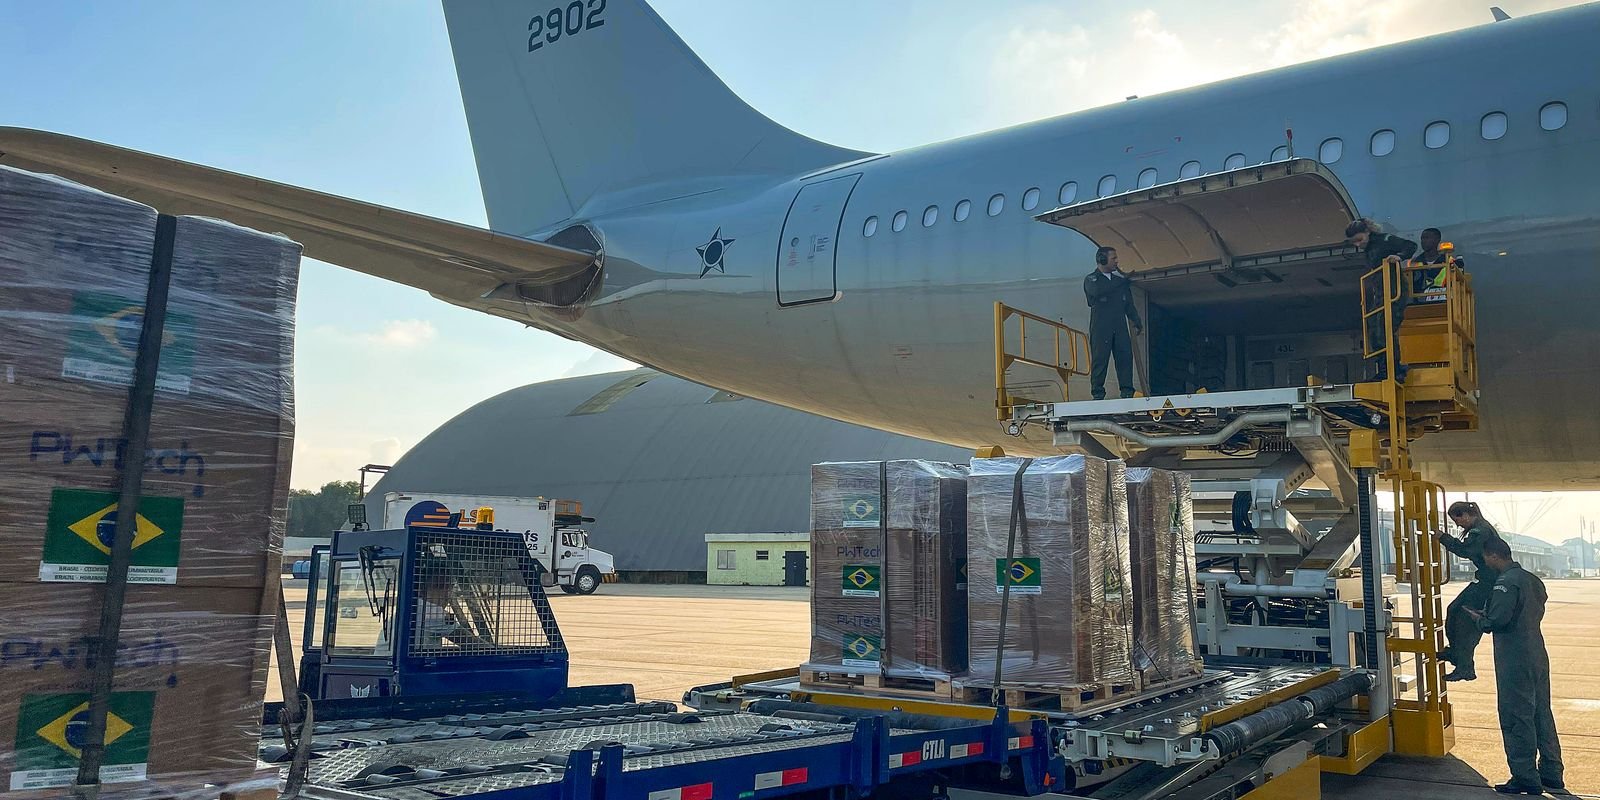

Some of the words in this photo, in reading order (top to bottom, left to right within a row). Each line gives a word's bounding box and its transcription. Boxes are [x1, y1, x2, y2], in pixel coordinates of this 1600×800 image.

[528, 0, 607, 52] 2902
[30, 431, 206, 477] PWTch
[922, 738, 945, 761] CTLA
